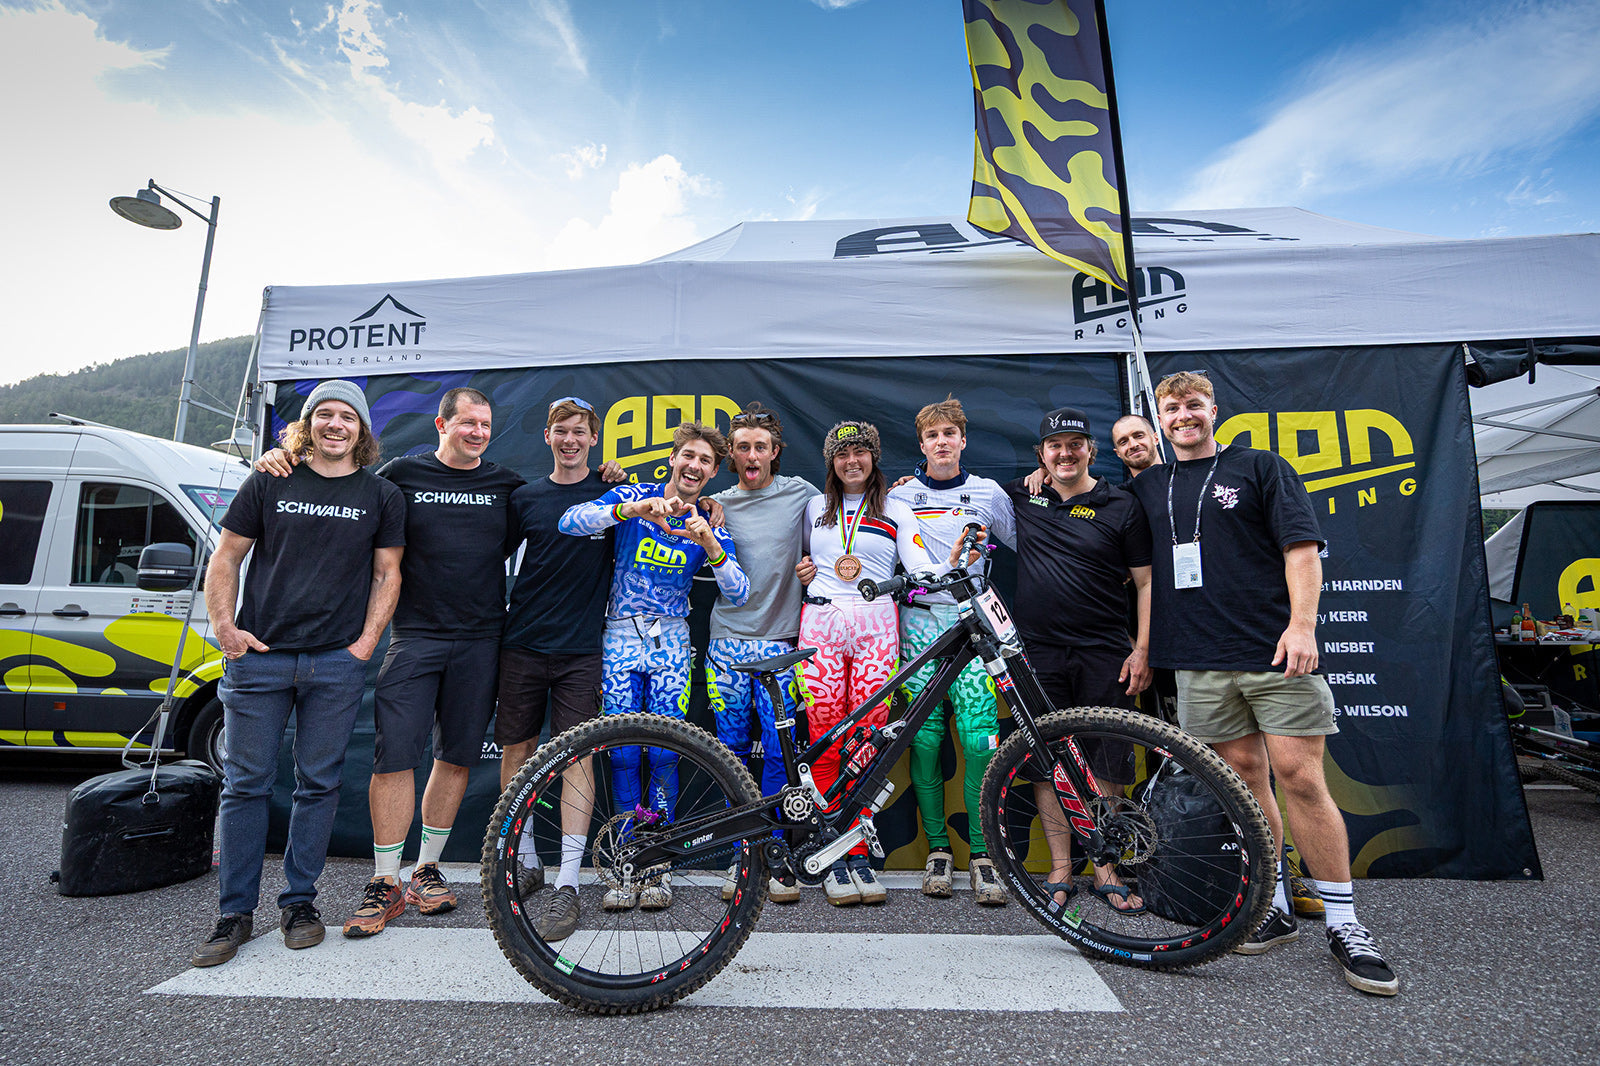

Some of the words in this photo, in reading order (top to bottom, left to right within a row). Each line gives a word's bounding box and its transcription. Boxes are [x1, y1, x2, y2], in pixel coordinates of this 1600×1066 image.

[1075, 303, 1188, 340] RACING
[288, 353, 422, 366] SWITZERLAND
[414, 491, 492, 505] SCHWALBE
[276, 499, 360, 521] SCHWALBE
[633, 563, 684, 575] RACING
[1331, 579, 1403, 591] HARNDEN
[990, 600, 1008, 625] 12
[1328, 611, 1369, 622] KERR
[1324, 641, 1375, 653] NISBET
[1343, 704, 1409, 717] WILSON
[530, 749, 568, 783] SCHWALBE
[508, 782, 534, 818] GRAVITY
[500, 815, 513, 836] PRO
[691, 832, 714, 847] sinter
[1010, 875, 1037, 908] SCHWALBE
[1035, 906, 1060, 928] MAGIC
[1059, 925, 1083, 940] MARY
[1081, 937, 1115, 954] GRAVITY
[1113, 948, 1132, 959] PRO
